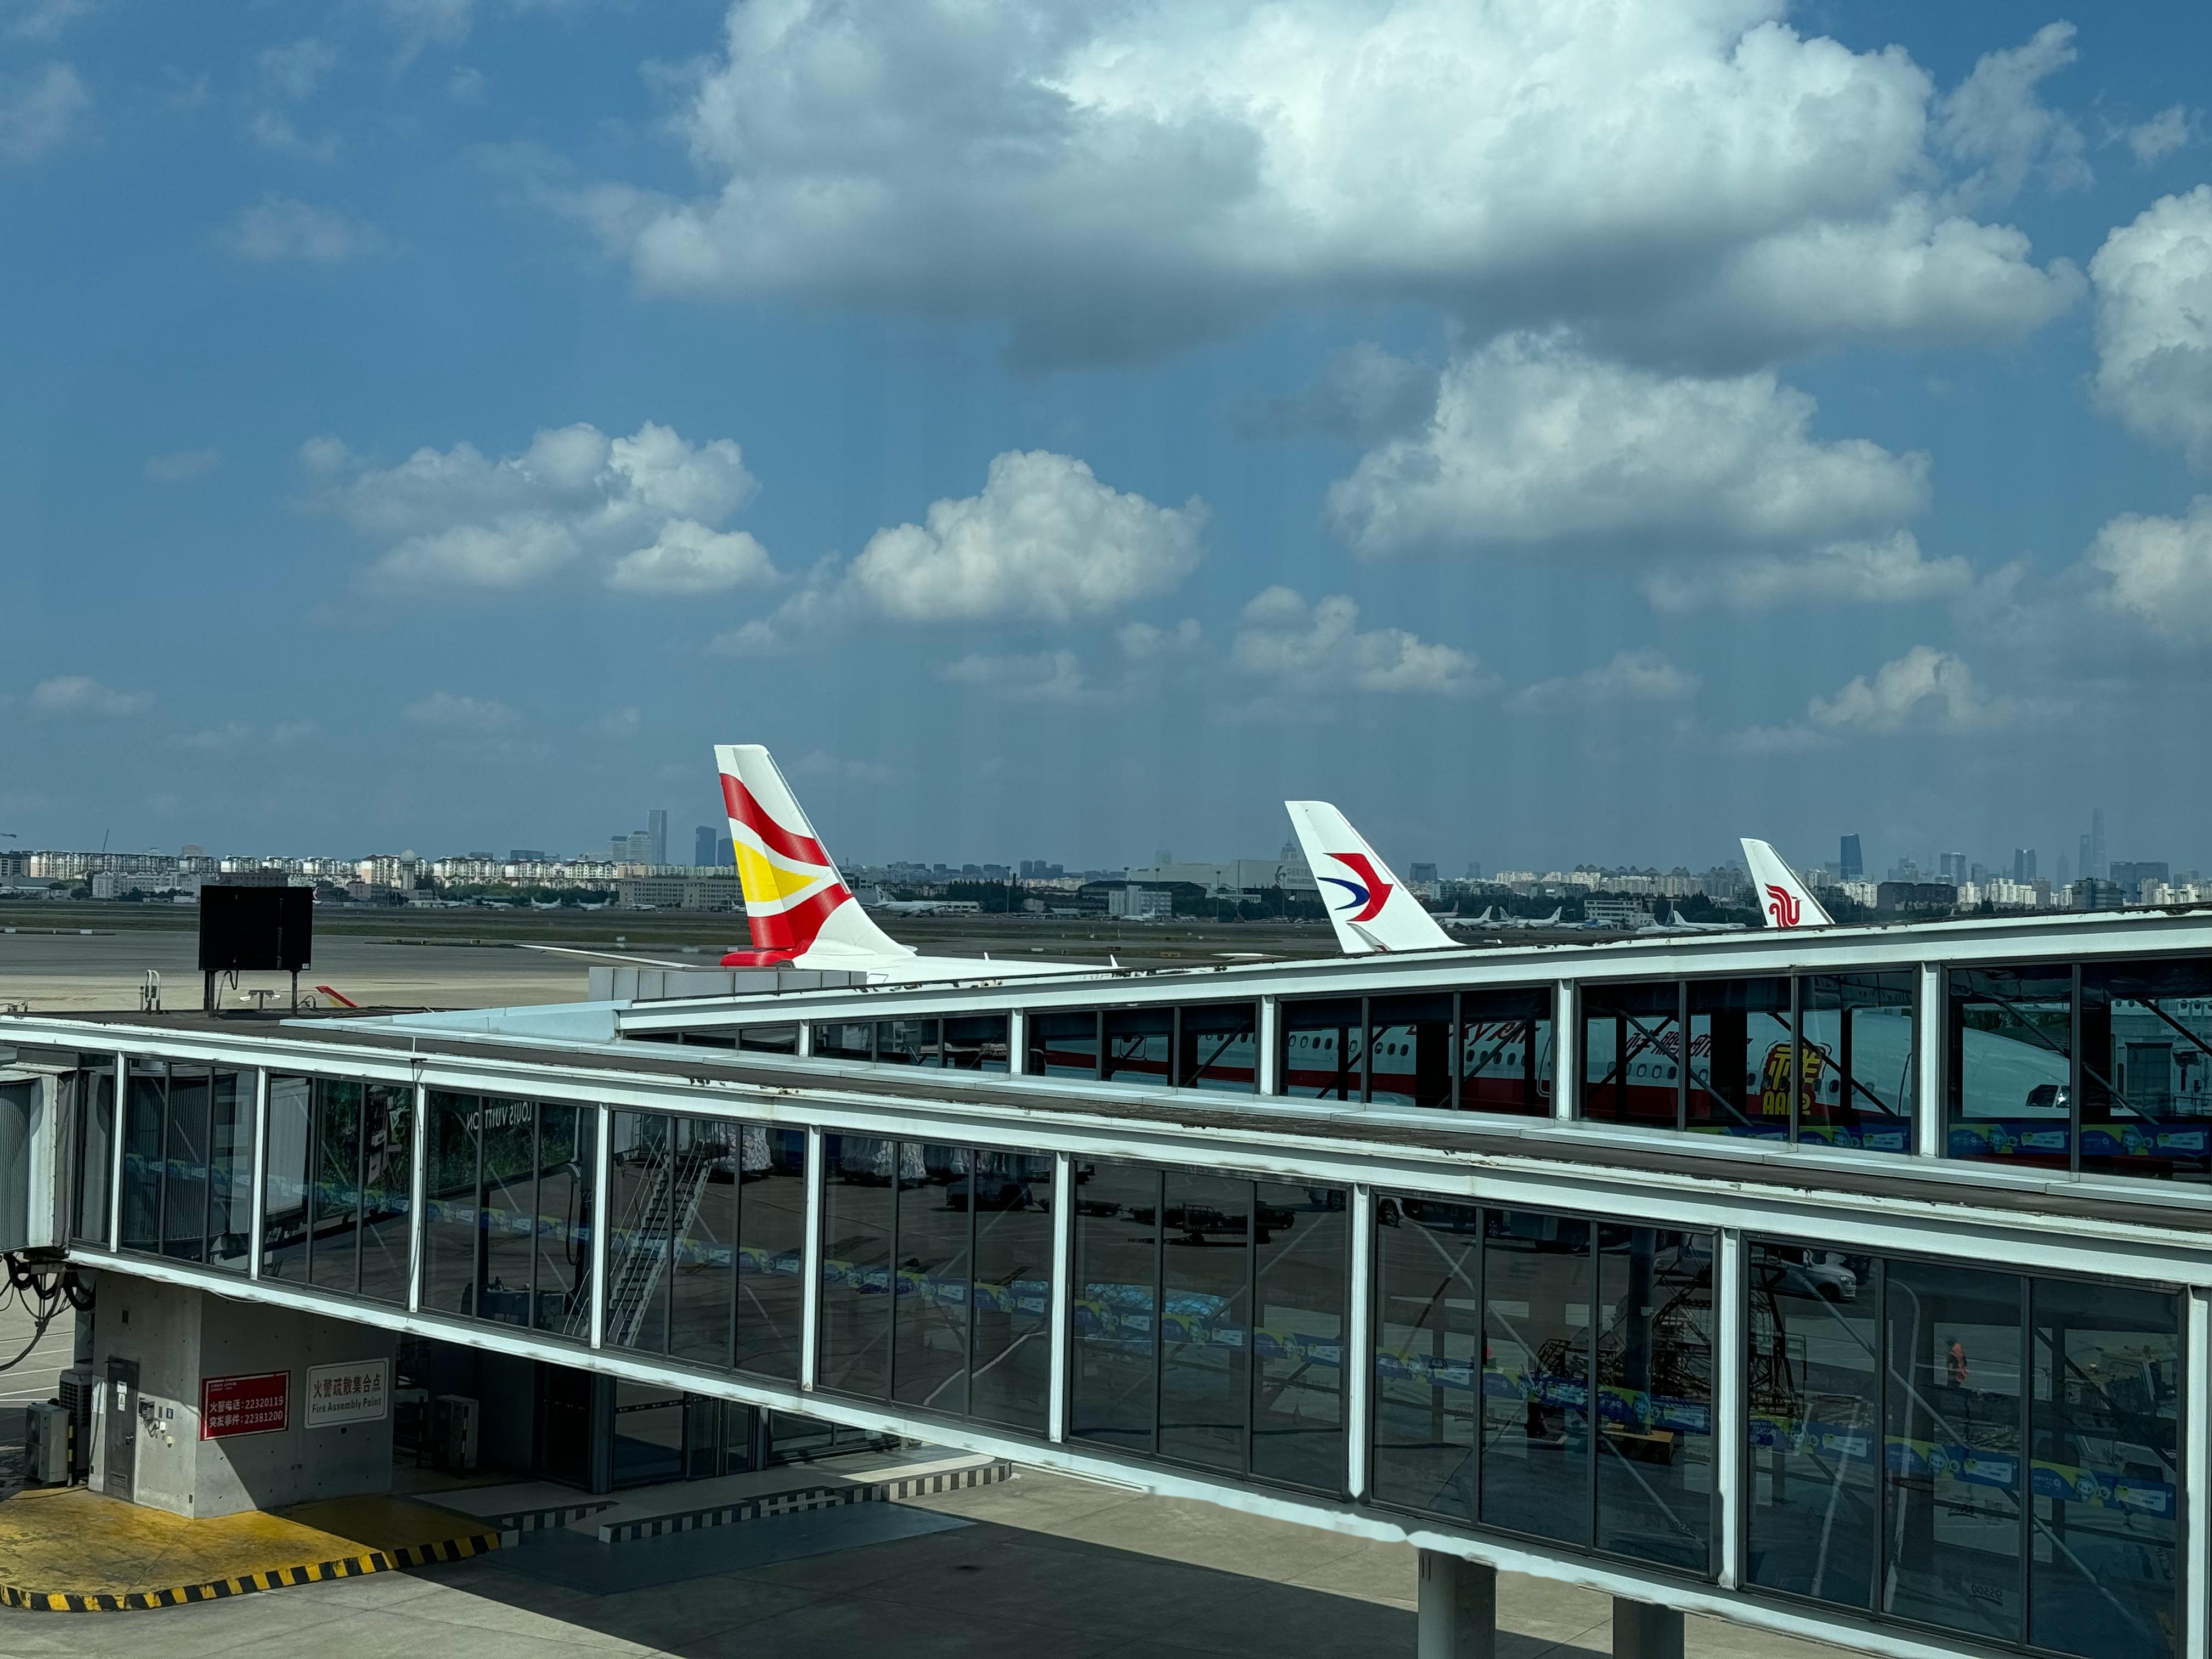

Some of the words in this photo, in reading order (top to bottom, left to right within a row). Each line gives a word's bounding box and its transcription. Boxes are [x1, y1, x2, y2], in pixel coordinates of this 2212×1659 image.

[313, 1373, 381, 1398] 火警疏散集合点
[312, 1403, 326, 1414] Fire
[328, 1401, 362, 1412] Assembly
[363, 1397, 381, 1408] Point
